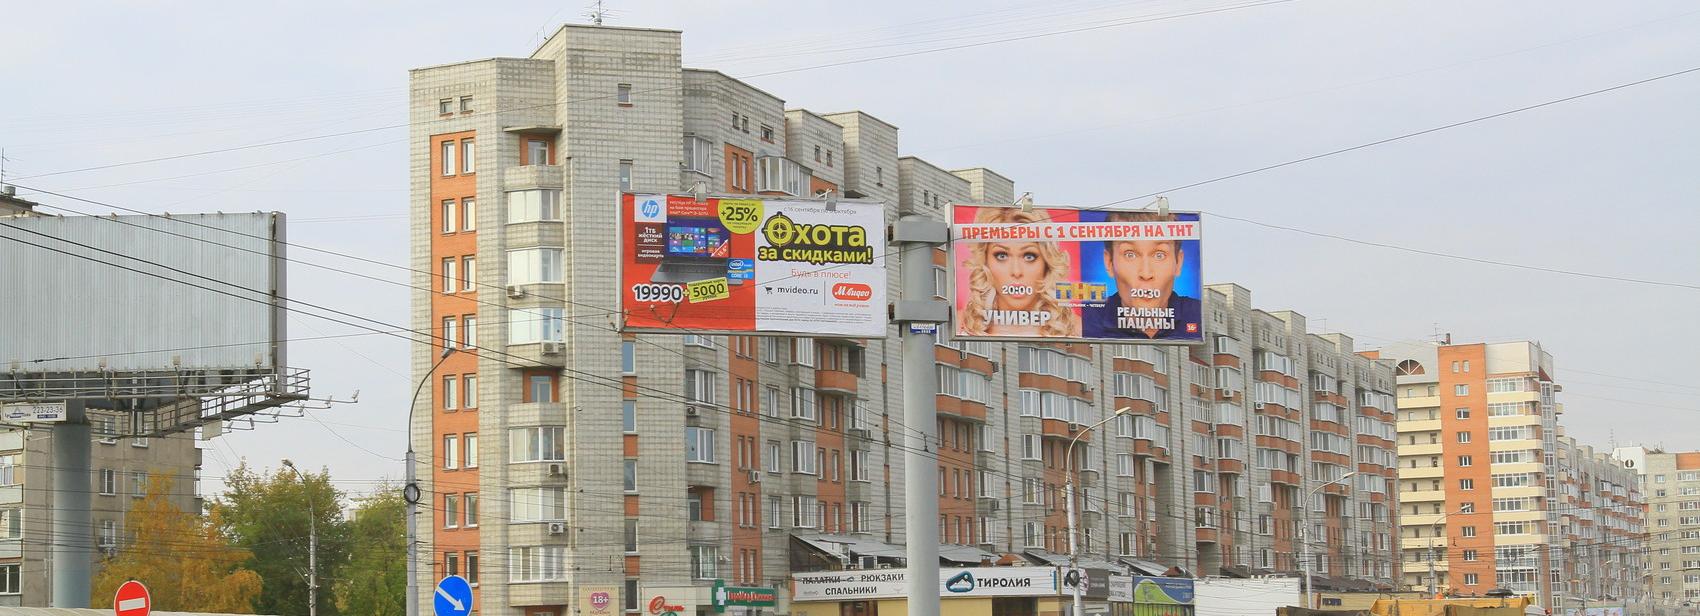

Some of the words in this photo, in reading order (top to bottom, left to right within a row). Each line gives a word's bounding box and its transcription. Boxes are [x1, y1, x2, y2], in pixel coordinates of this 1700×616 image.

[644, 200, 658, 218] hp
[721, 206, 758, 222] +25%
[763, 213, 866, 247] Охота
[961, 226, 1040, 239] ПРЕМЬЕРЫ
[1044, 226, 1053, 238] С
[1056, 226, 1065, 238] 1
[1069, 225, 1141, 238] СЕНТЯБРЯ
[1145, 225, 1164, 237] НА
[1168, 224, 1193, 236] ТНТ
[759, 248, 777, 260] за
[783, 247, 872, 263] скидками!
[791, 268, 810, 280] Будь
[820, 271, 851, 279] плюсе!
[633, 285, 683, 301] 19990
[693, 283, 725, 298] 5000
[777, 286, 819, 295] mvideo.ru
[1001, 286, 1033, 295] 20:00
[1056, 283, 1107, 300] ТНТ
[1130, 288, 1161, 298] 20:30
[983, 310, 1051, 326] УНИВЕР
[1117, 307, 1175, 318] РЕАЛЬНЫЕ
[1117, 318, 1175, 331] ПАЦАНЫ
[802, 576, 841, 584] ПАЛАТКИ
[861, 573, 904, 582] РЮКЗАКИ
[977, 578, 1031, 587] ТИРОЛИЯ
[825, 586, 877, 595] СПАЛЬНИКИ
[593, 596, 609, 604] 18+
